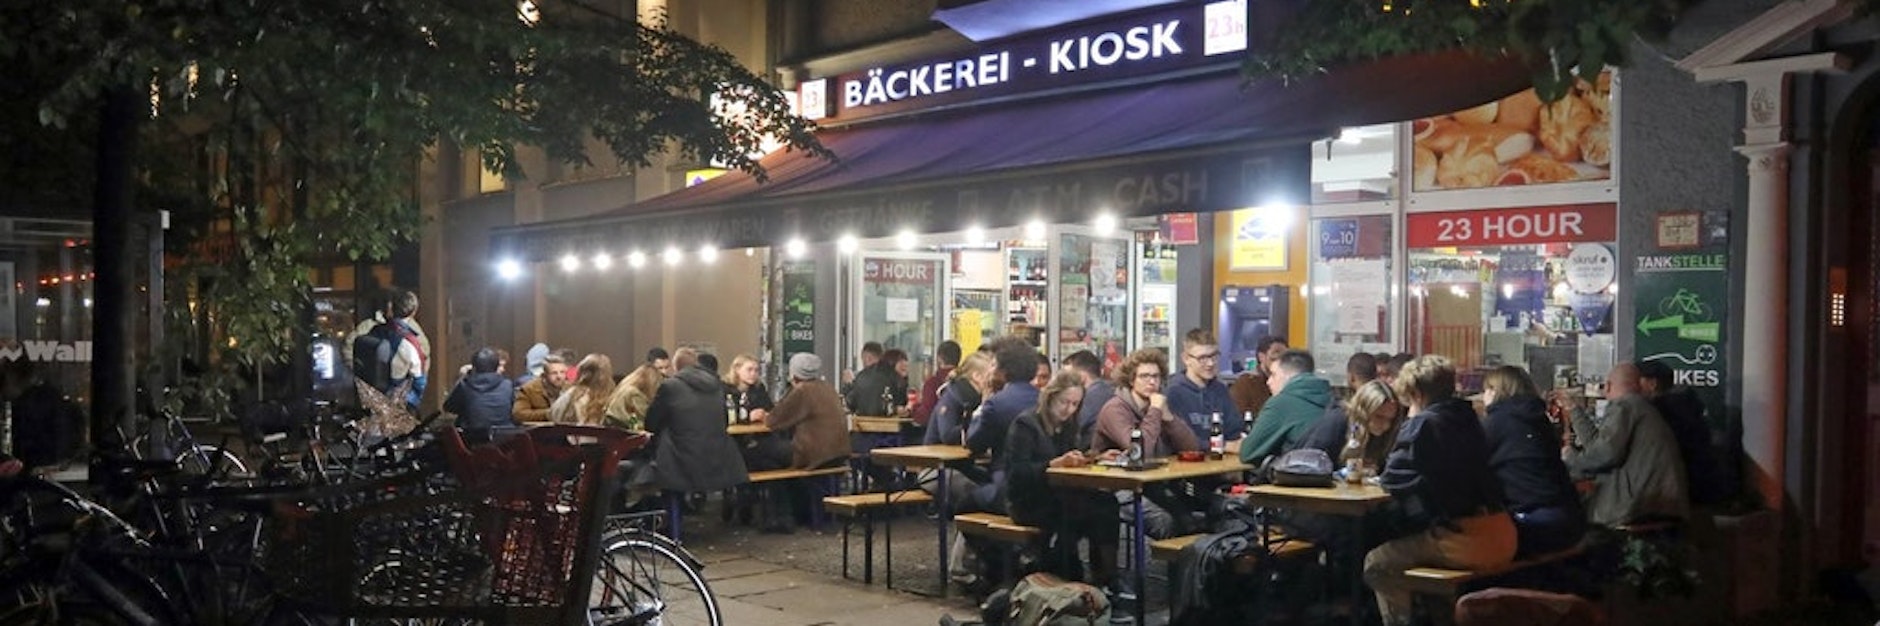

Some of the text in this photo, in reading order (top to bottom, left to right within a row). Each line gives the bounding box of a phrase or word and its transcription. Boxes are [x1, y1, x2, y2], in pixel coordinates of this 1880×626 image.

[1208, 14, 1244, 39] 23h
[844, 51, 1009, 108] BÄCKEREI
[1050, 20, 1183, 74] KIOSK
[1007, 169, 1208, 216] ATM CASH
[1339, 230, 1354, 245] 10
[1437, 211, 1584, 242] 23 HOUR
[882, 263, 928, 280] HOUR
[1637, 255, 1724, 268] TANKSTELLE
[23, 340, 93, 362] Wall
[1673, 369, 1720, 387] IKES
